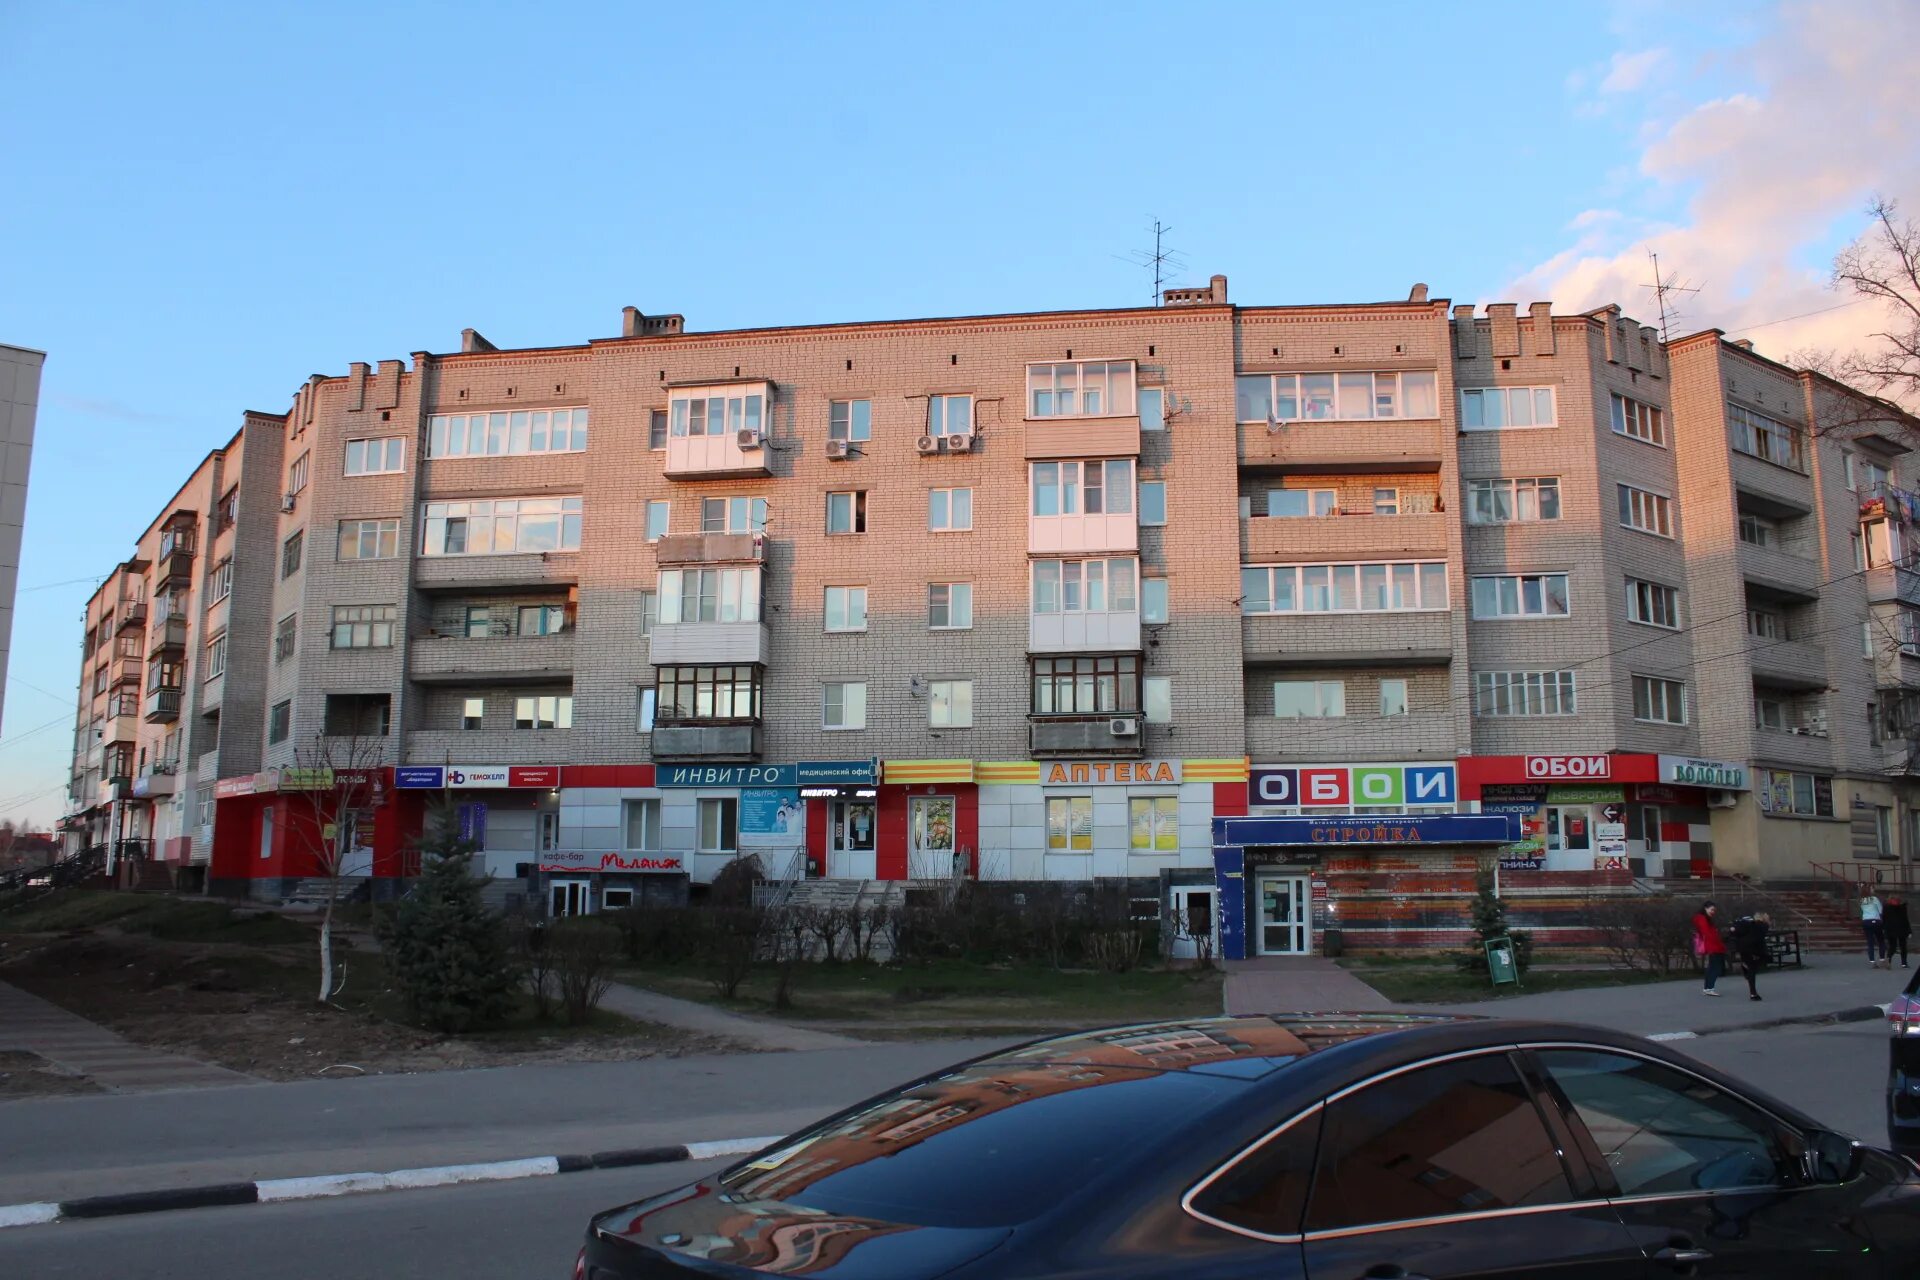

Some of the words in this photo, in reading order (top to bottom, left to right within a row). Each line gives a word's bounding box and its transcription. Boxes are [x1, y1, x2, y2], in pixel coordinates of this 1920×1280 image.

[800, 768, 849, 777] медицинский
[1048, 762, 1174, 783] АПТЕКА
[1530, 757, 1606, 776] ОБОИ
[469, 773, 505, 781] ГЕМОХЕЛП
[673, 767, 779, 783] ИНВИТРО
[1673, 765, 1742, 787] ВОДОЛЕЙ
[743, 789, 778, 798] ИНВИТРО
[801, 789, 838, 797] ИНВИТРО
[1259, 771, 1447, 801] ОБОИ
[1311, 825, 1422, 841] СТРОЙКА
[543, 852, 584, 861] кафе-бар
[601, 853, 681, 870] Меланж
